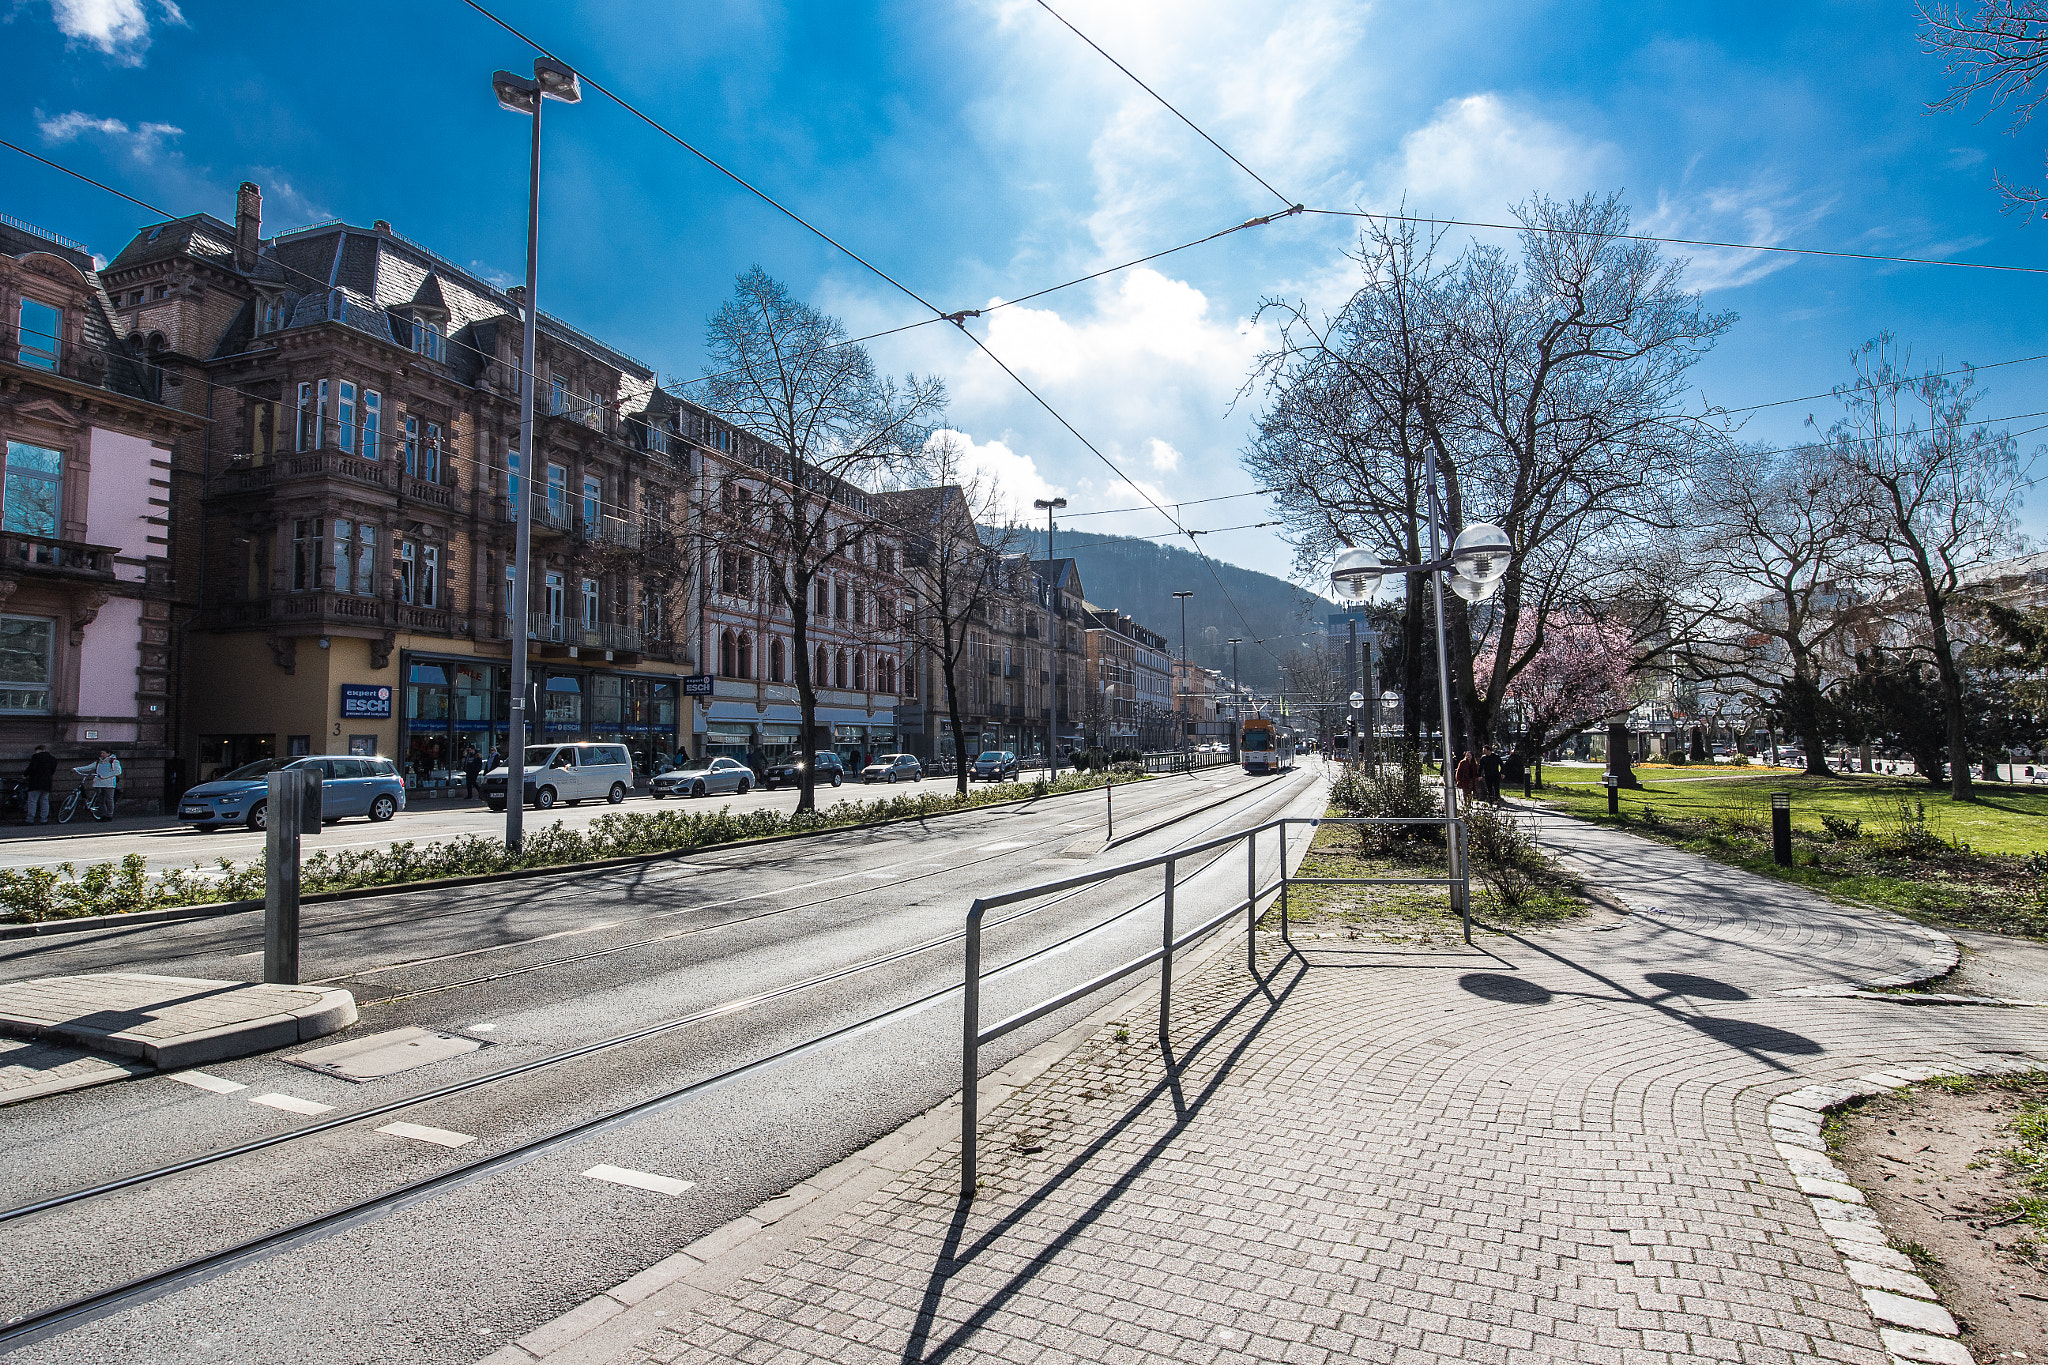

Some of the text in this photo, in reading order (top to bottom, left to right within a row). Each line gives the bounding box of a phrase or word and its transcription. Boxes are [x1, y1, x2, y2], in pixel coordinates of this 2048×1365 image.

[686, 684, 711, 692] ESCH
[346, 699, 390, 712] ESCH
[332, 722, 341, 736] 3
[563, 723, 581, 731] ESCH
